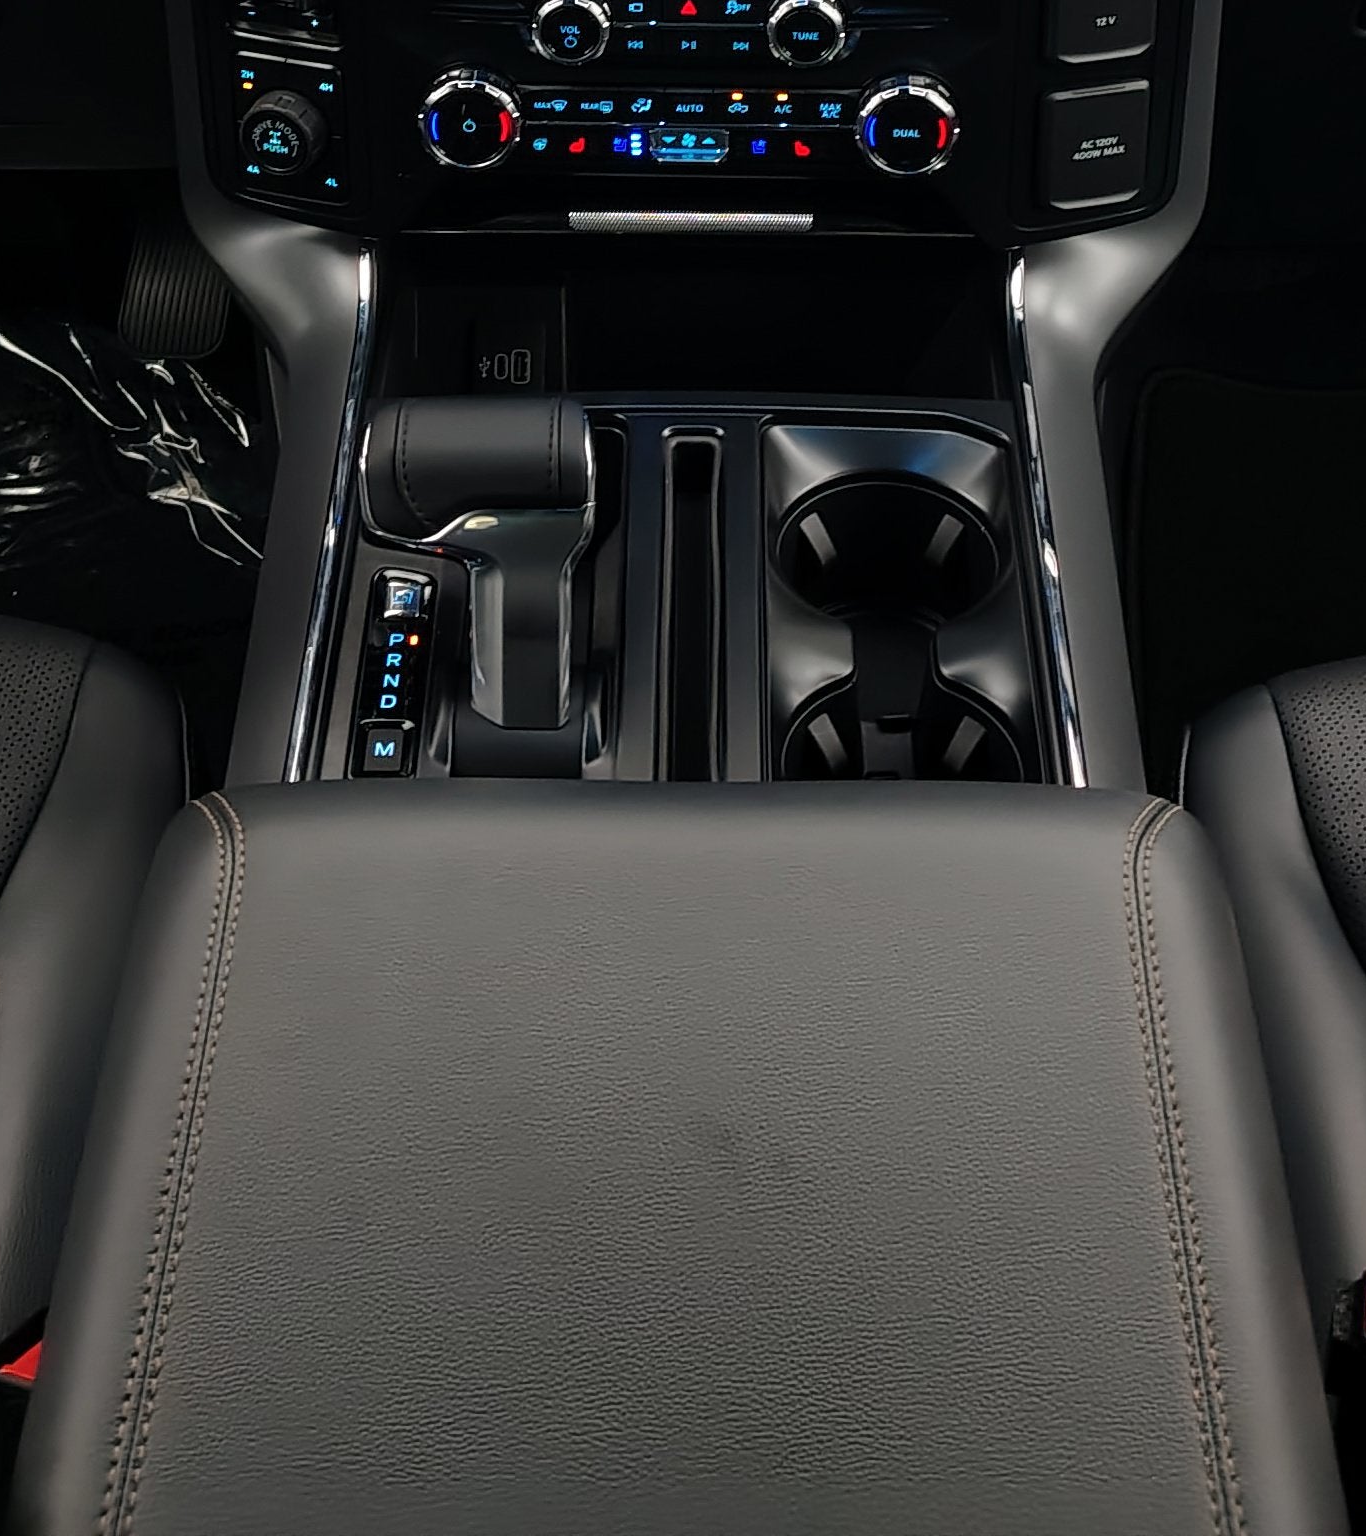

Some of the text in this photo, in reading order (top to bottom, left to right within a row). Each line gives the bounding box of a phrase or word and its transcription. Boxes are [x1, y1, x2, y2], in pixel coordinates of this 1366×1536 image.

[1095, 15, 1118, 27] 12 V
[560, 25, 581, 35] VOL
[792, 31, 820, 41] TUNE
[240, 69, 255, 80] 2H
[533, 101, 552, 109] MAX
[675, 103, 704, 114] AUTO
[773, 104, 793, 114] A/C
[819, 102, 842, 112] MAX
[821, 111, 841, 119] A/C
[251, 119, 300, 146] DRIVE MODE
[892, 128, 921, 139] DUAL
[262, 142, 289, 155] PUSH
[1081, 140, 1094, 150] AC
[1102, 144, 1126, 157] MAX
[246, 165, 261, 175] 4A
[324, 177, 339, 188] 4L
[388, 633, 405, 647] P
[386, 653, 403, 667] R
[382, 673, 401, 688] N
[379, 694, 398, 709] D
[373, 741, 396, 757] M
